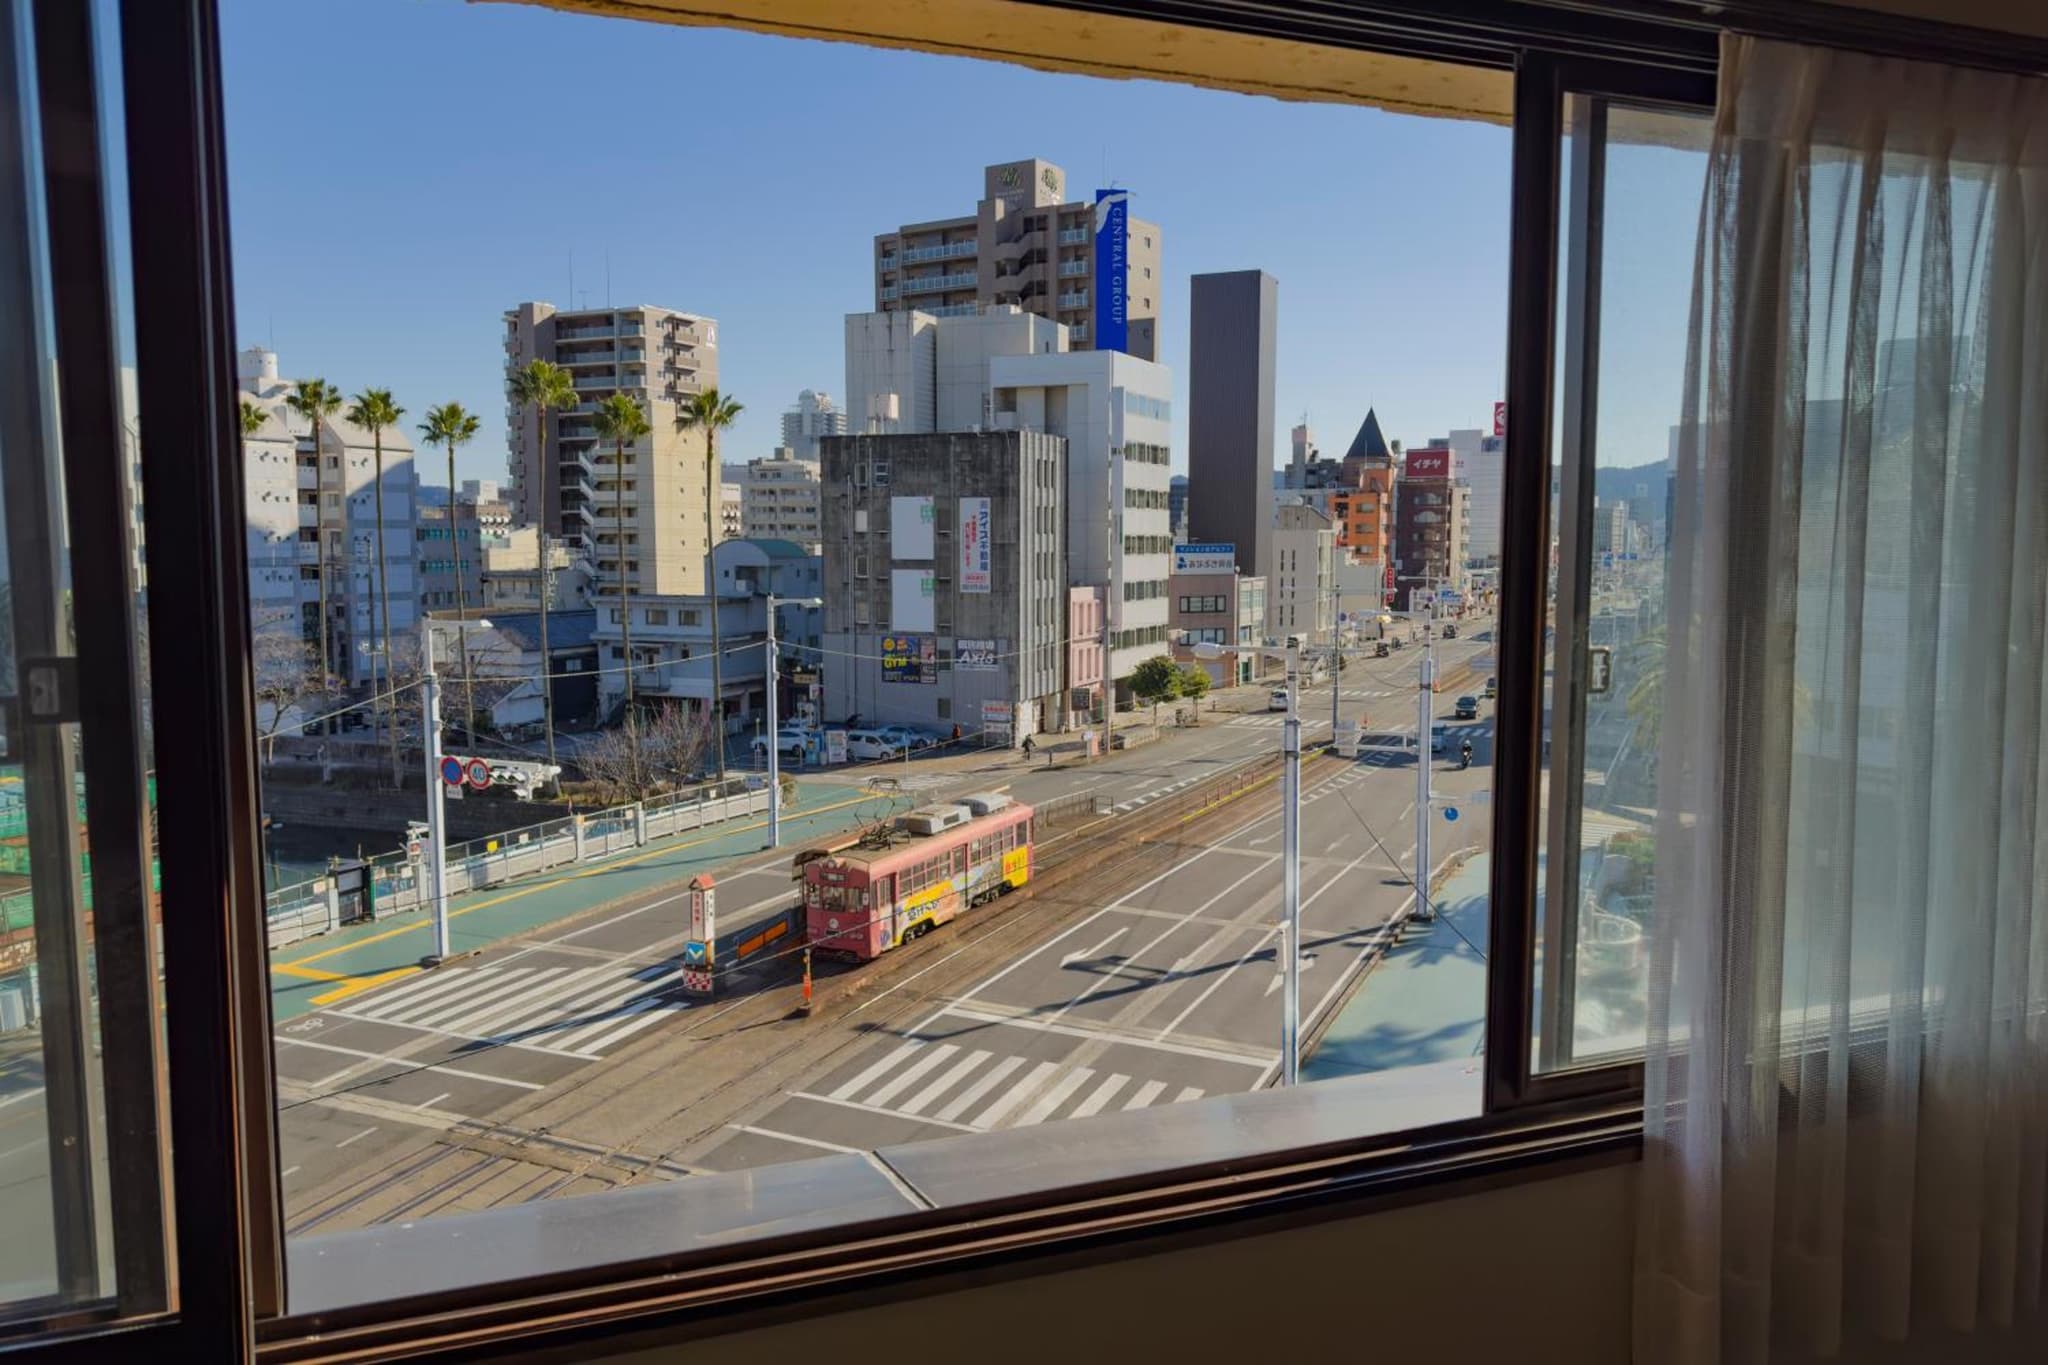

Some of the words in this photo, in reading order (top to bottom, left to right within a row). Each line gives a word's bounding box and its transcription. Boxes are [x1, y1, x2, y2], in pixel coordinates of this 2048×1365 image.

[1111, 207, 1123, 271] CENTRAL
[1111, 277, 1122, 324] GROUP
[883, 653, 908, 668] GYM
[959, 650, 995, 666] Axis
[473, 767, 485, 782] 40
